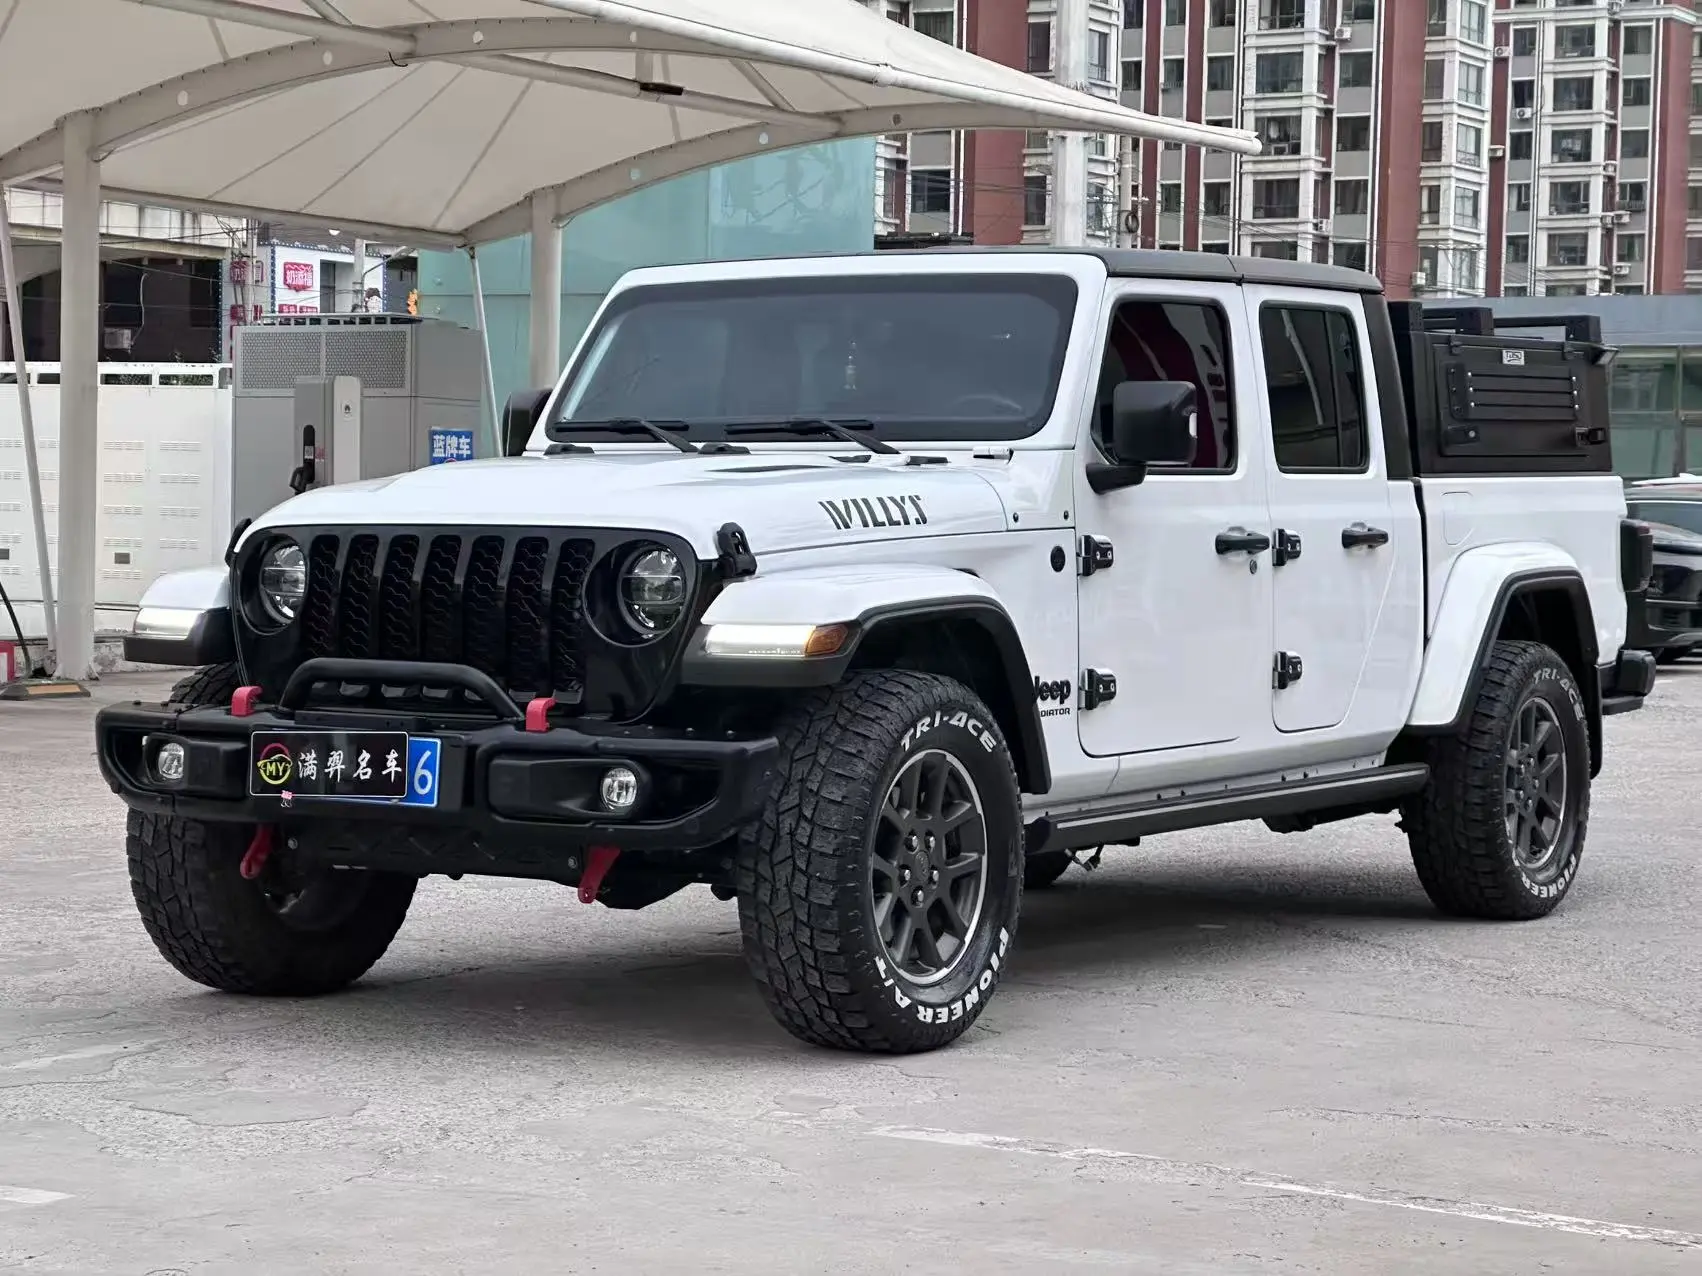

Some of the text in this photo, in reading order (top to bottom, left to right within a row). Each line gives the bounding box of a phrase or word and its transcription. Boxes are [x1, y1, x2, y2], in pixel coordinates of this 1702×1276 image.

[432, 434, 471, 458] 蓝牌车
[818, 494, 928, 530] WILLYS
[1033, 676, 1071, 705] Jeep
[1533, 667, 1583, 721] TRI-ACE
[1040, 707, 1070, 717] DIATOR
[901, 710, 997, 752] TRI-ACE
[266, 762, 284, 776] MY
[298, 749, 402, 782] 满羿名车
[414, 750, 433, 795] 6
[1521, 853, 1576, 897] PIONEER
[916, 927, 1009, 1024] PIONEER
